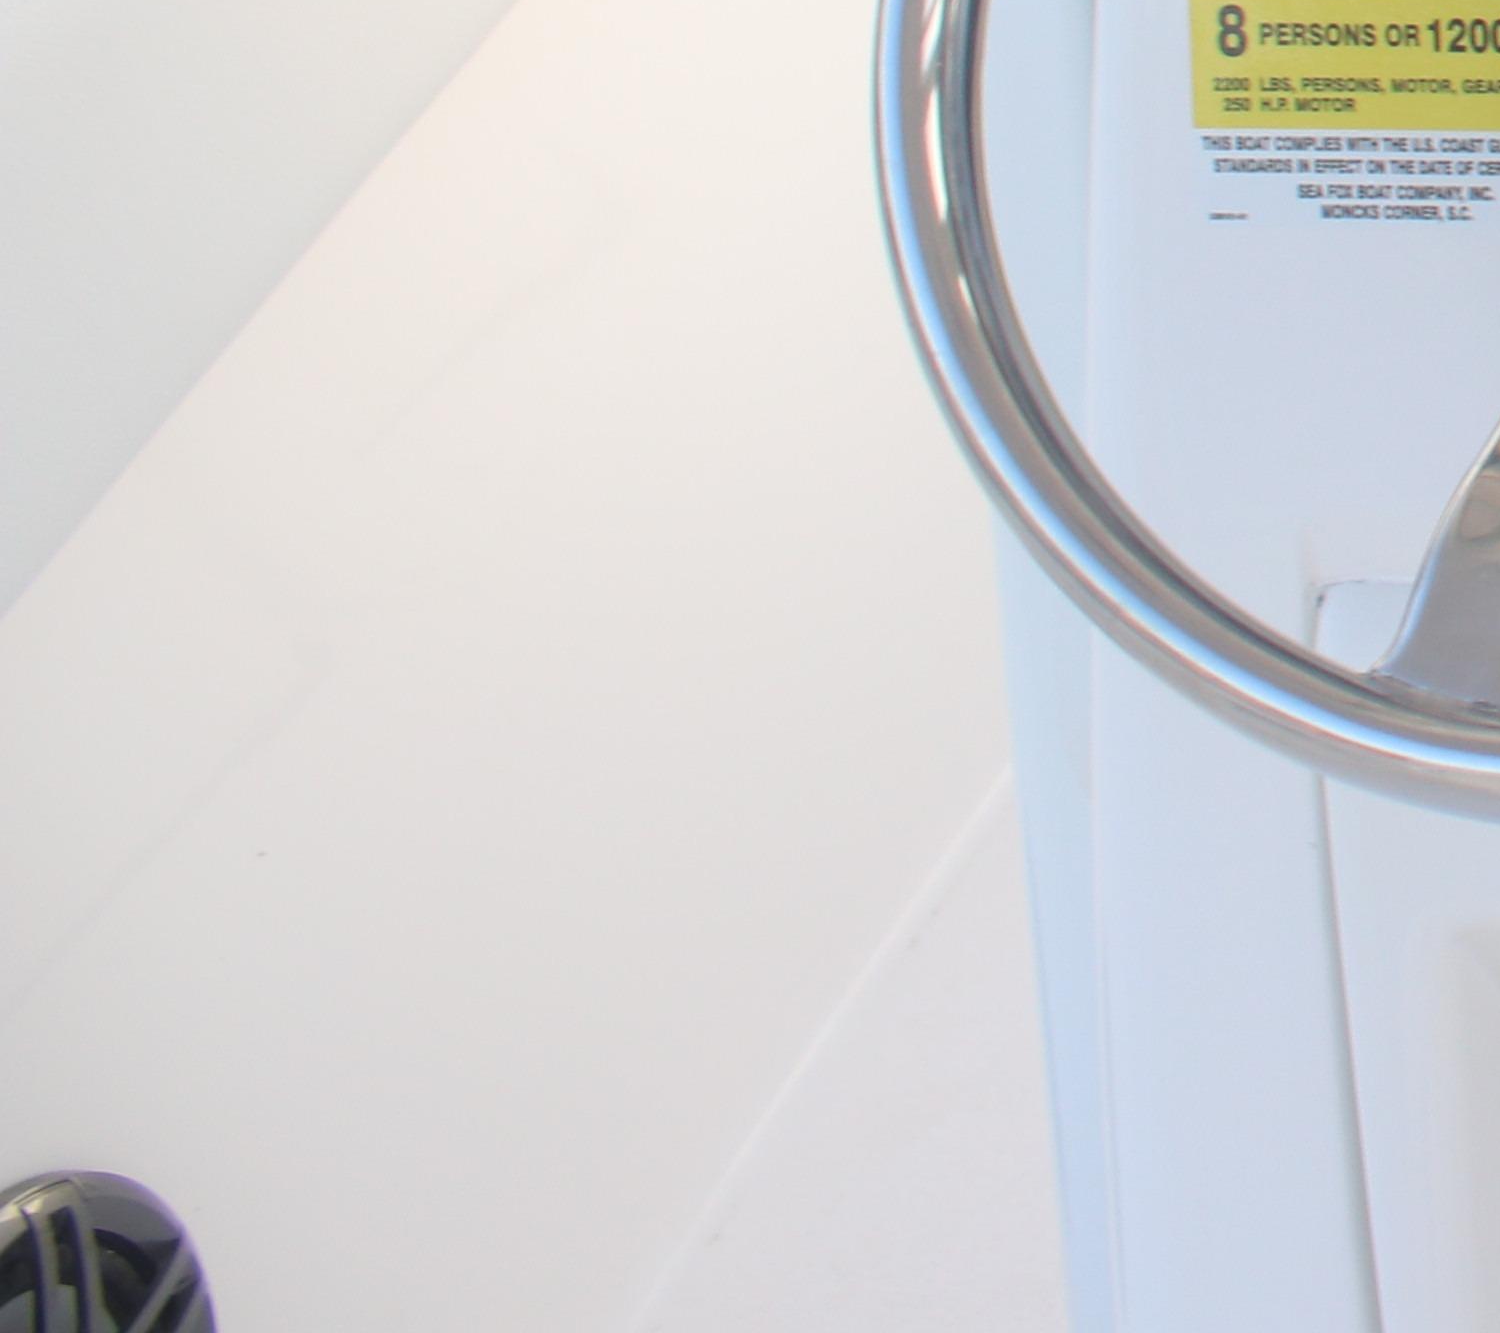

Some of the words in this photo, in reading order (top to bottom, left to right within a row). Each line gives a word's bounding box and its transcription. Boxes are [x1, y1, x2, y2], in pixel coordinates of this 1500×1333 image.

[1218, 4, 1247, 57] 8
[1259, 23, 1377, 47] PERSONS
[1385, 24, 1421, 47] OR
[1223, 98, 1250, 111] 250
[1295, 98, 1355, 112] MOTOR
[1202, 136, 1231, 150] THIS
[1236, 136, 1270, 150] BOAT
[1274, 136, 1342, 151] COMPLIES
[1383, 137, 1409, 152] THE
[1440, 138, 1484, 153] COAST
[1214, 158, 1292, 173] STANDARDS
[1389, 160, 1414, 174] THE
[1419, 161, 1452, 175] DATE
[1297, 184, 1324, 198] SEA
[1357, 185, 1392, 199] BOAT
